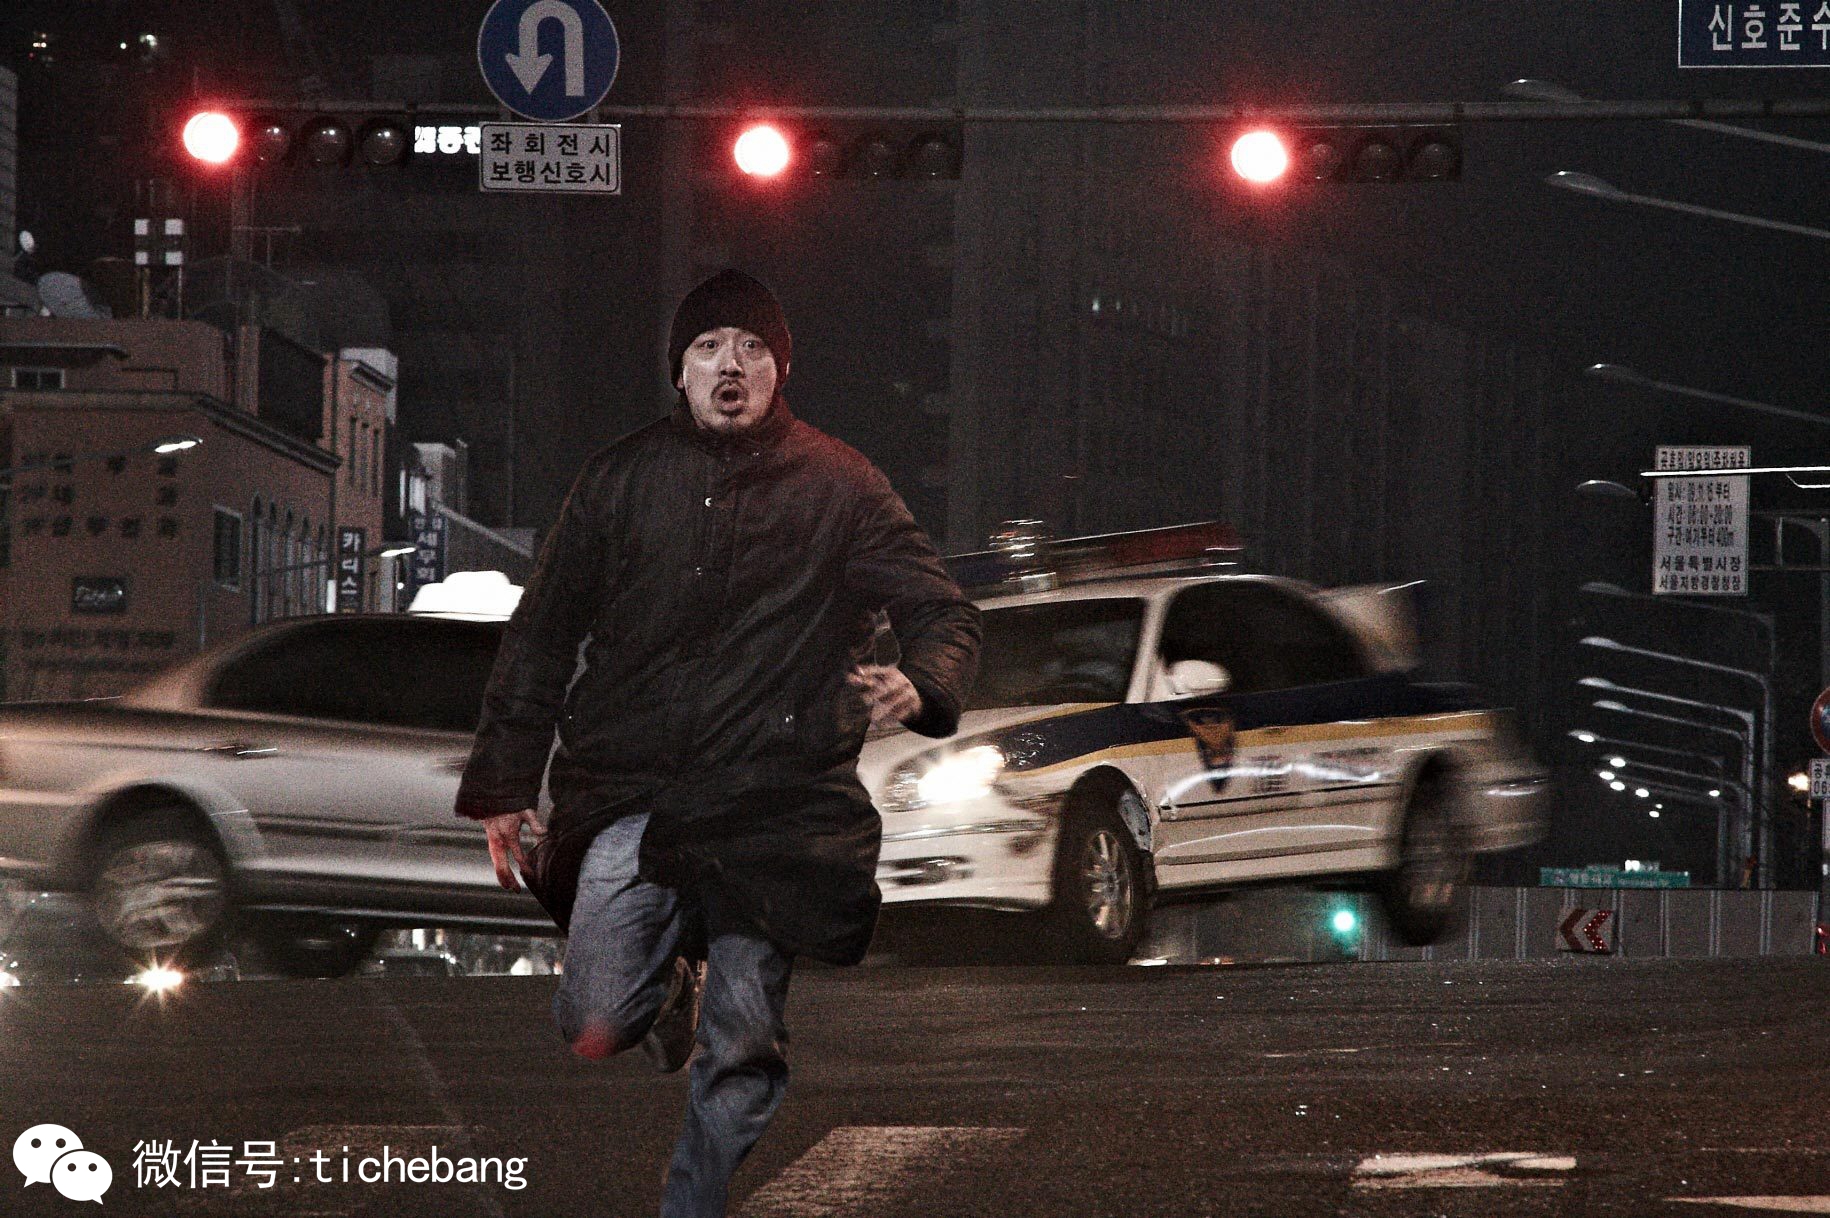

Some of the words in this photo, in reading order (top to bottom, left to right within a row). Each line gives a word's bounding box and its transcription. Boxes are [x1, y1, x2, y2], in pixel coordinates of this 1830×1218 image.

[1707, 1, 1830, 51] 신호준수
[490, 160, 610, 186] 보행신호시
[1660, 555, 1741, 572] 서울특별시장
